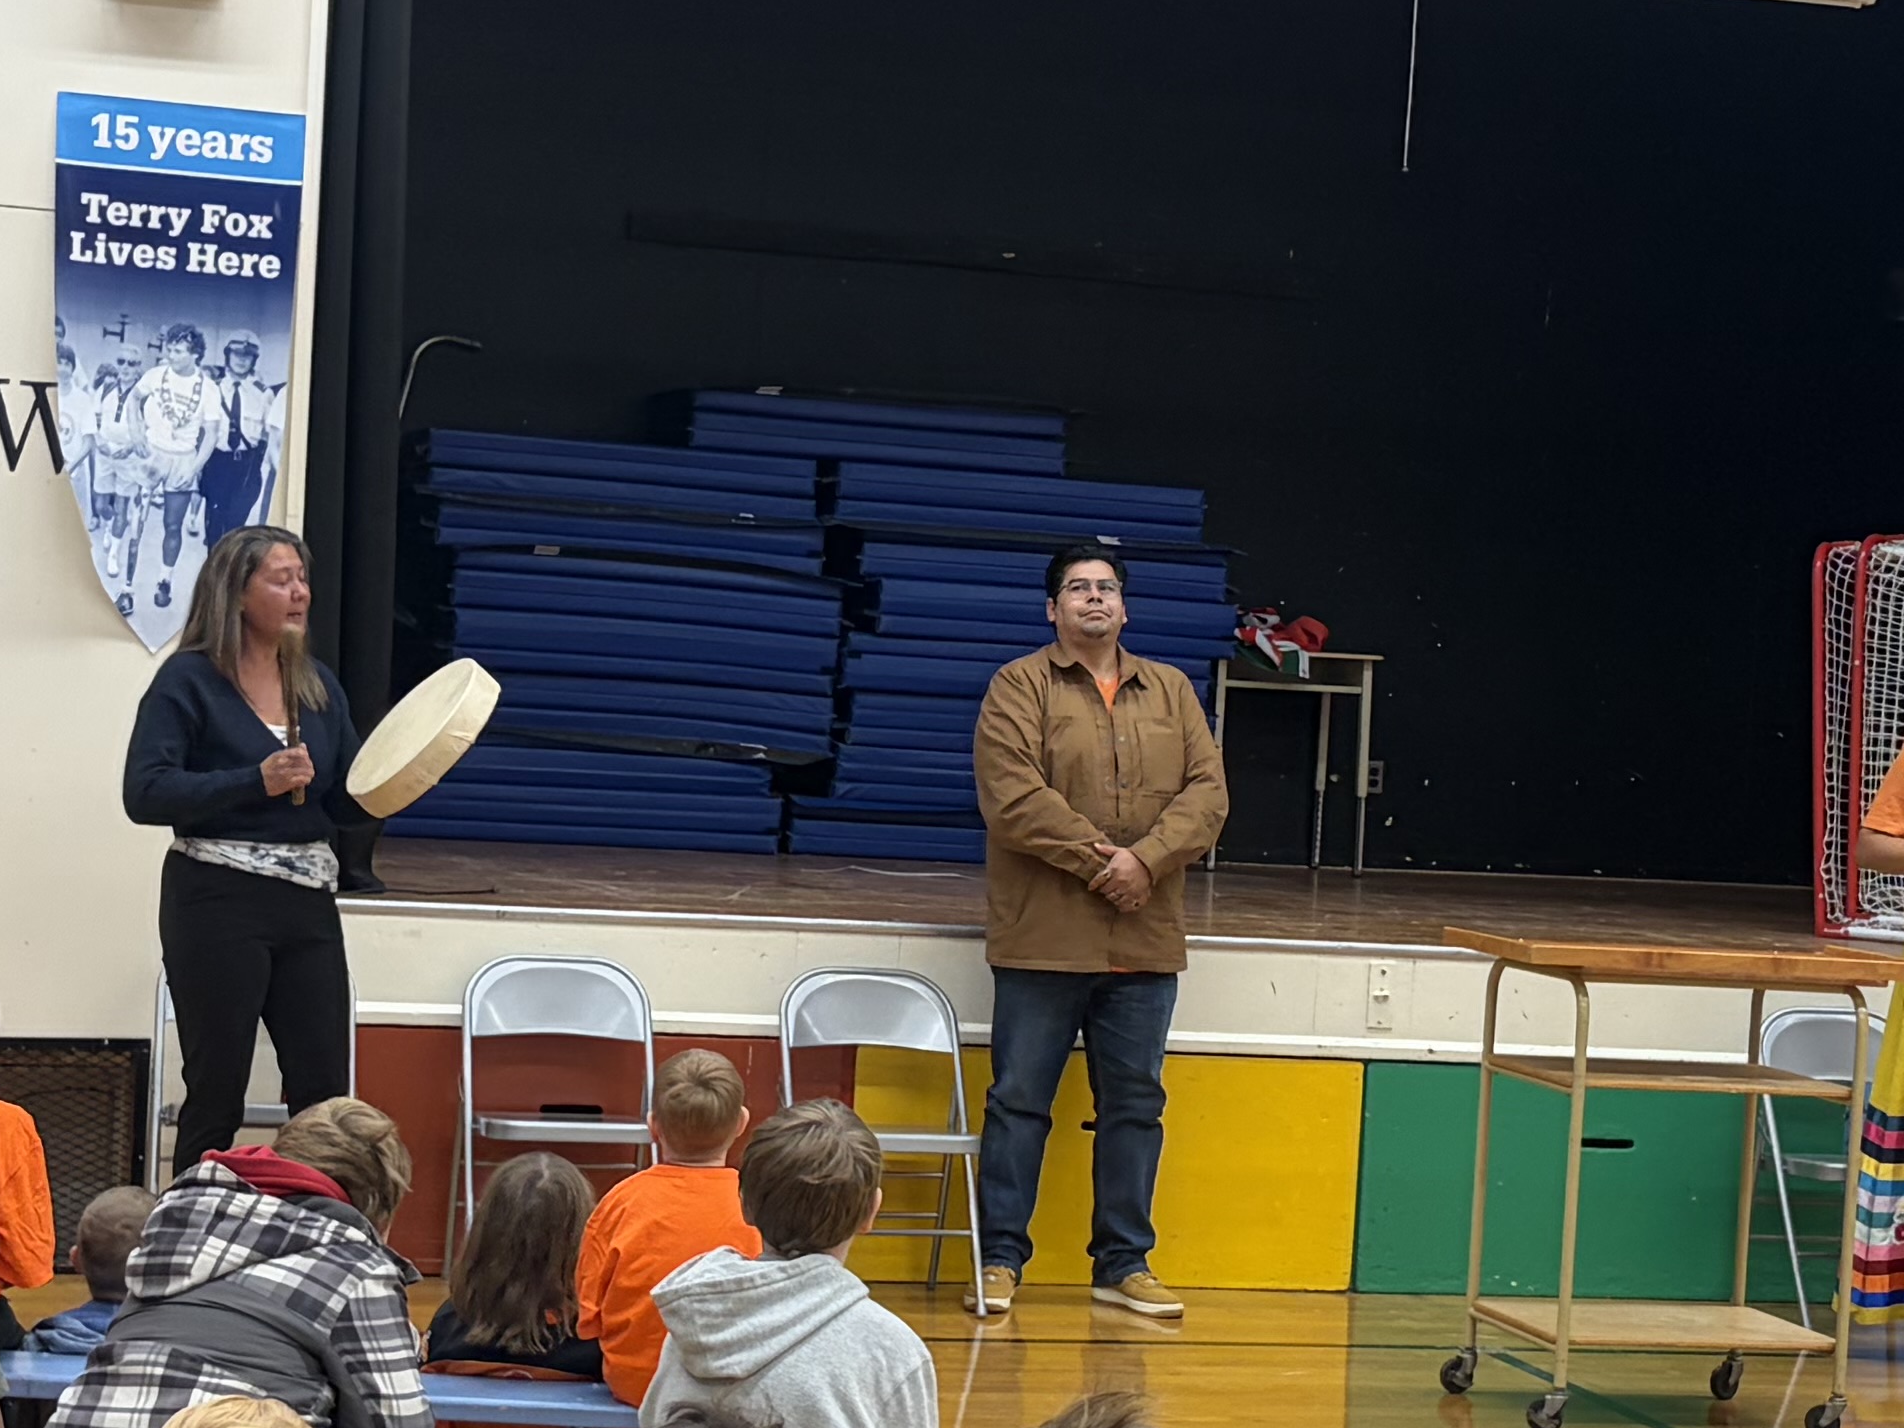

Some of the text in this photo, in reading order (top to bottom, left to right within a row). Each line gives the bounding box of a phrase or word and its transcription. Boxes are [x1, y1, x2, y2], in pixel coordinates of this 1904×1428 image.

[90, 112, 274, 164] 15 years
[80, 191, 274, 239] Terry Fox
[69, 230, 282, 279] Lives Here
